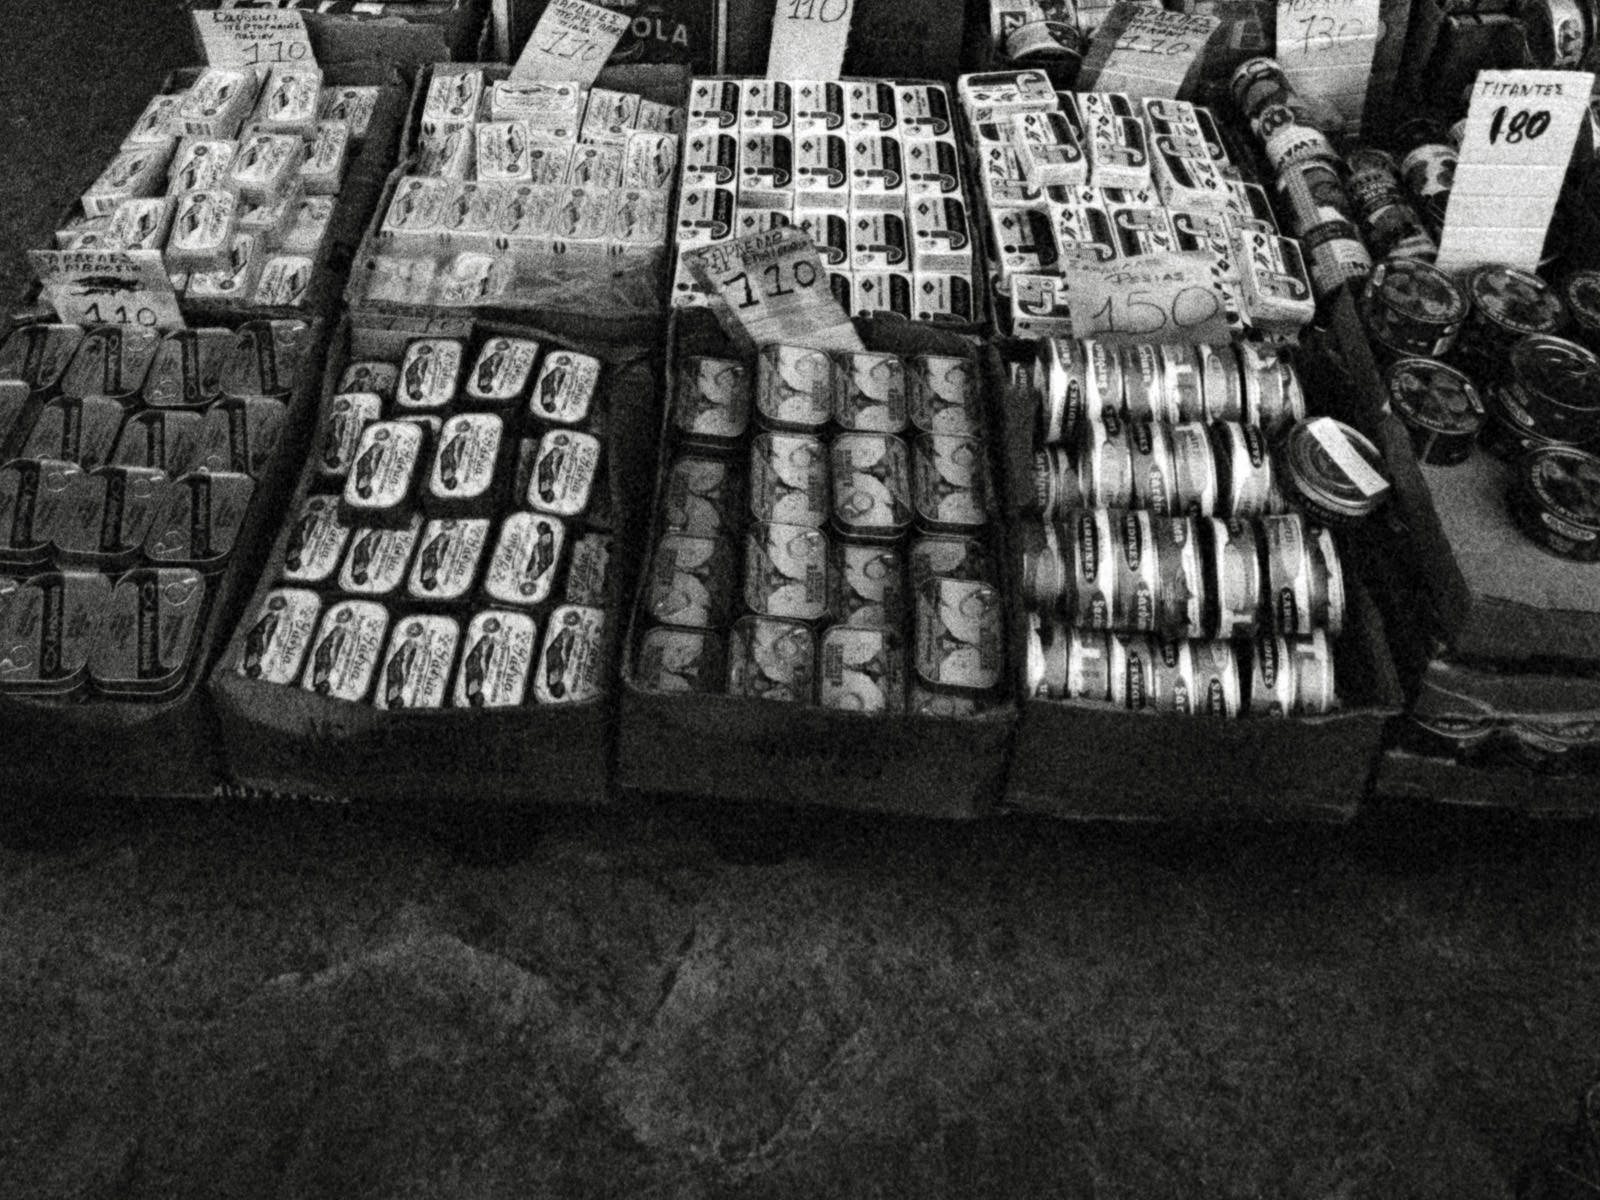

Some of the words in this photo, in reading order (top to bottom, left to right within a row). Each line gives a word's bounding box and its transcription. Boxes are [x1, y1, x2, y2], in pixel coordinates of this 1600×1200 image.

[242, 41, 306, 67] 110
[1489, 105, 1552, 146] 180
[723, 260, 818, 308] 110
[84, 302, 158, 328] 110
[1089, 285, 1221, 335] 150
